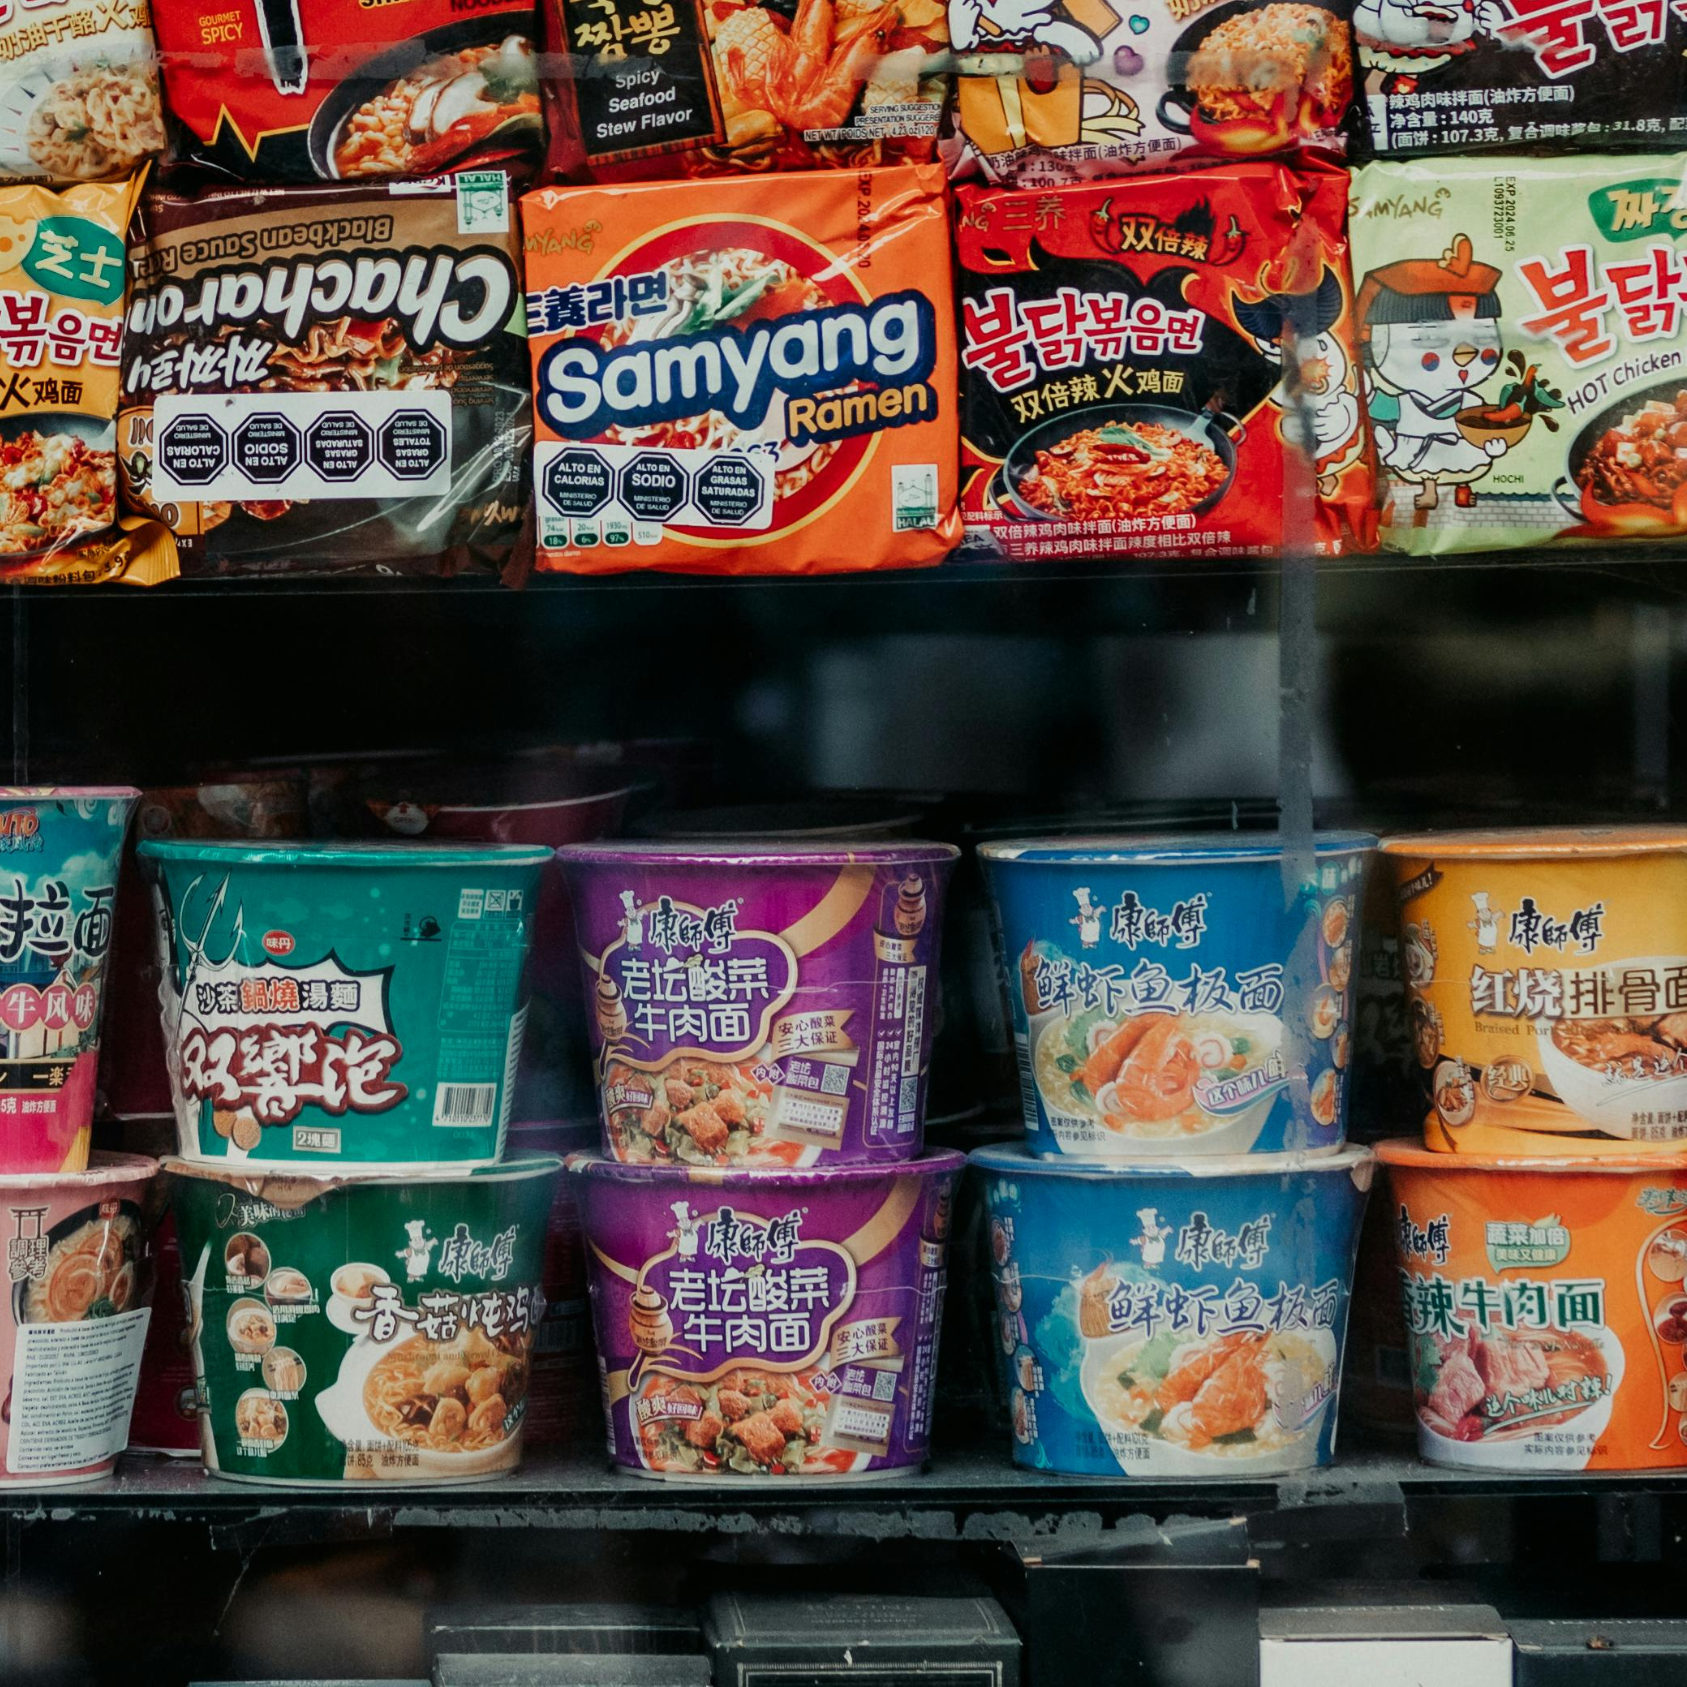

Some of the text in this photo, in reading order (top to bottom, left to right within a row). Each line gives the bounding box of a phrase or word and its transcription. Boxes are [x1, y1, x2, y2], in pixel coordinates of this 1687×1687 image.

[199, 11, 241, 27] GOURMET
[201, 24, 243, 44] SPICY
[575, 4, 681, 58] 짬뽕
[609, 88, 676, 113] Seafood
[616, 69, 661, 89] Spicy
[1389, 85, 1575, 109] 辣鸡肉味拌面(油炸方便面)
[596, 107, 693, 138] Stew Flavor
[34, 229, 122, 289] 芝士
[181, 217, 394, 262] Blackbean Sauce
[1121, 216, 1209, 261] 双倍辣
[547, 300, 920, 424] Samyang
[964, 290, 1204, 391] 불닭볶음면
[1011, 363, 1184, 423] 双倍辣火鸡面
[1568, 352, 1682, 415] HOT Chicken
[788, 383, 928, 437] Ramen
[166, 445, 221, 455] CALORIAS
[244, 443, 288, 453] SODIO
[558, 464, 601, 473] ALTO EN
[554, 475, 604, 485] CALORIAS
[632, 475, 676, 487] SODIO
[1493, 474, 1524, 484] HOCHI
[650, 897, 738, 954] 康師傅
[1111, 890, 1207, 950] 康師傅
[1509, 896, 1605, 956] 康師傅
[197, 978, 360, 1014] 沙茶鍋燒湯麵
[621, 956, 769, 1002] 老坛酸菜
[1037, 958, 1284, 1017] 鲜虾鱼板面
[634, 1003, 751, 1043] 牛肉面
[706, 1206, 801, 1265] 康師傅
[1176, 1212, 1270, 1270] 康師傅
[1485, 1222, 1566, 1246] 蔬菜加倍
[1495, 1249, 1557, 1262] 美味又健康
[668, 1266, 830, 1312] 老坛酸菜
[1107, 1278, 1338, 1338] 鲜虾鱼板面
[684, 1313, 811, 1353] 牛肉面
